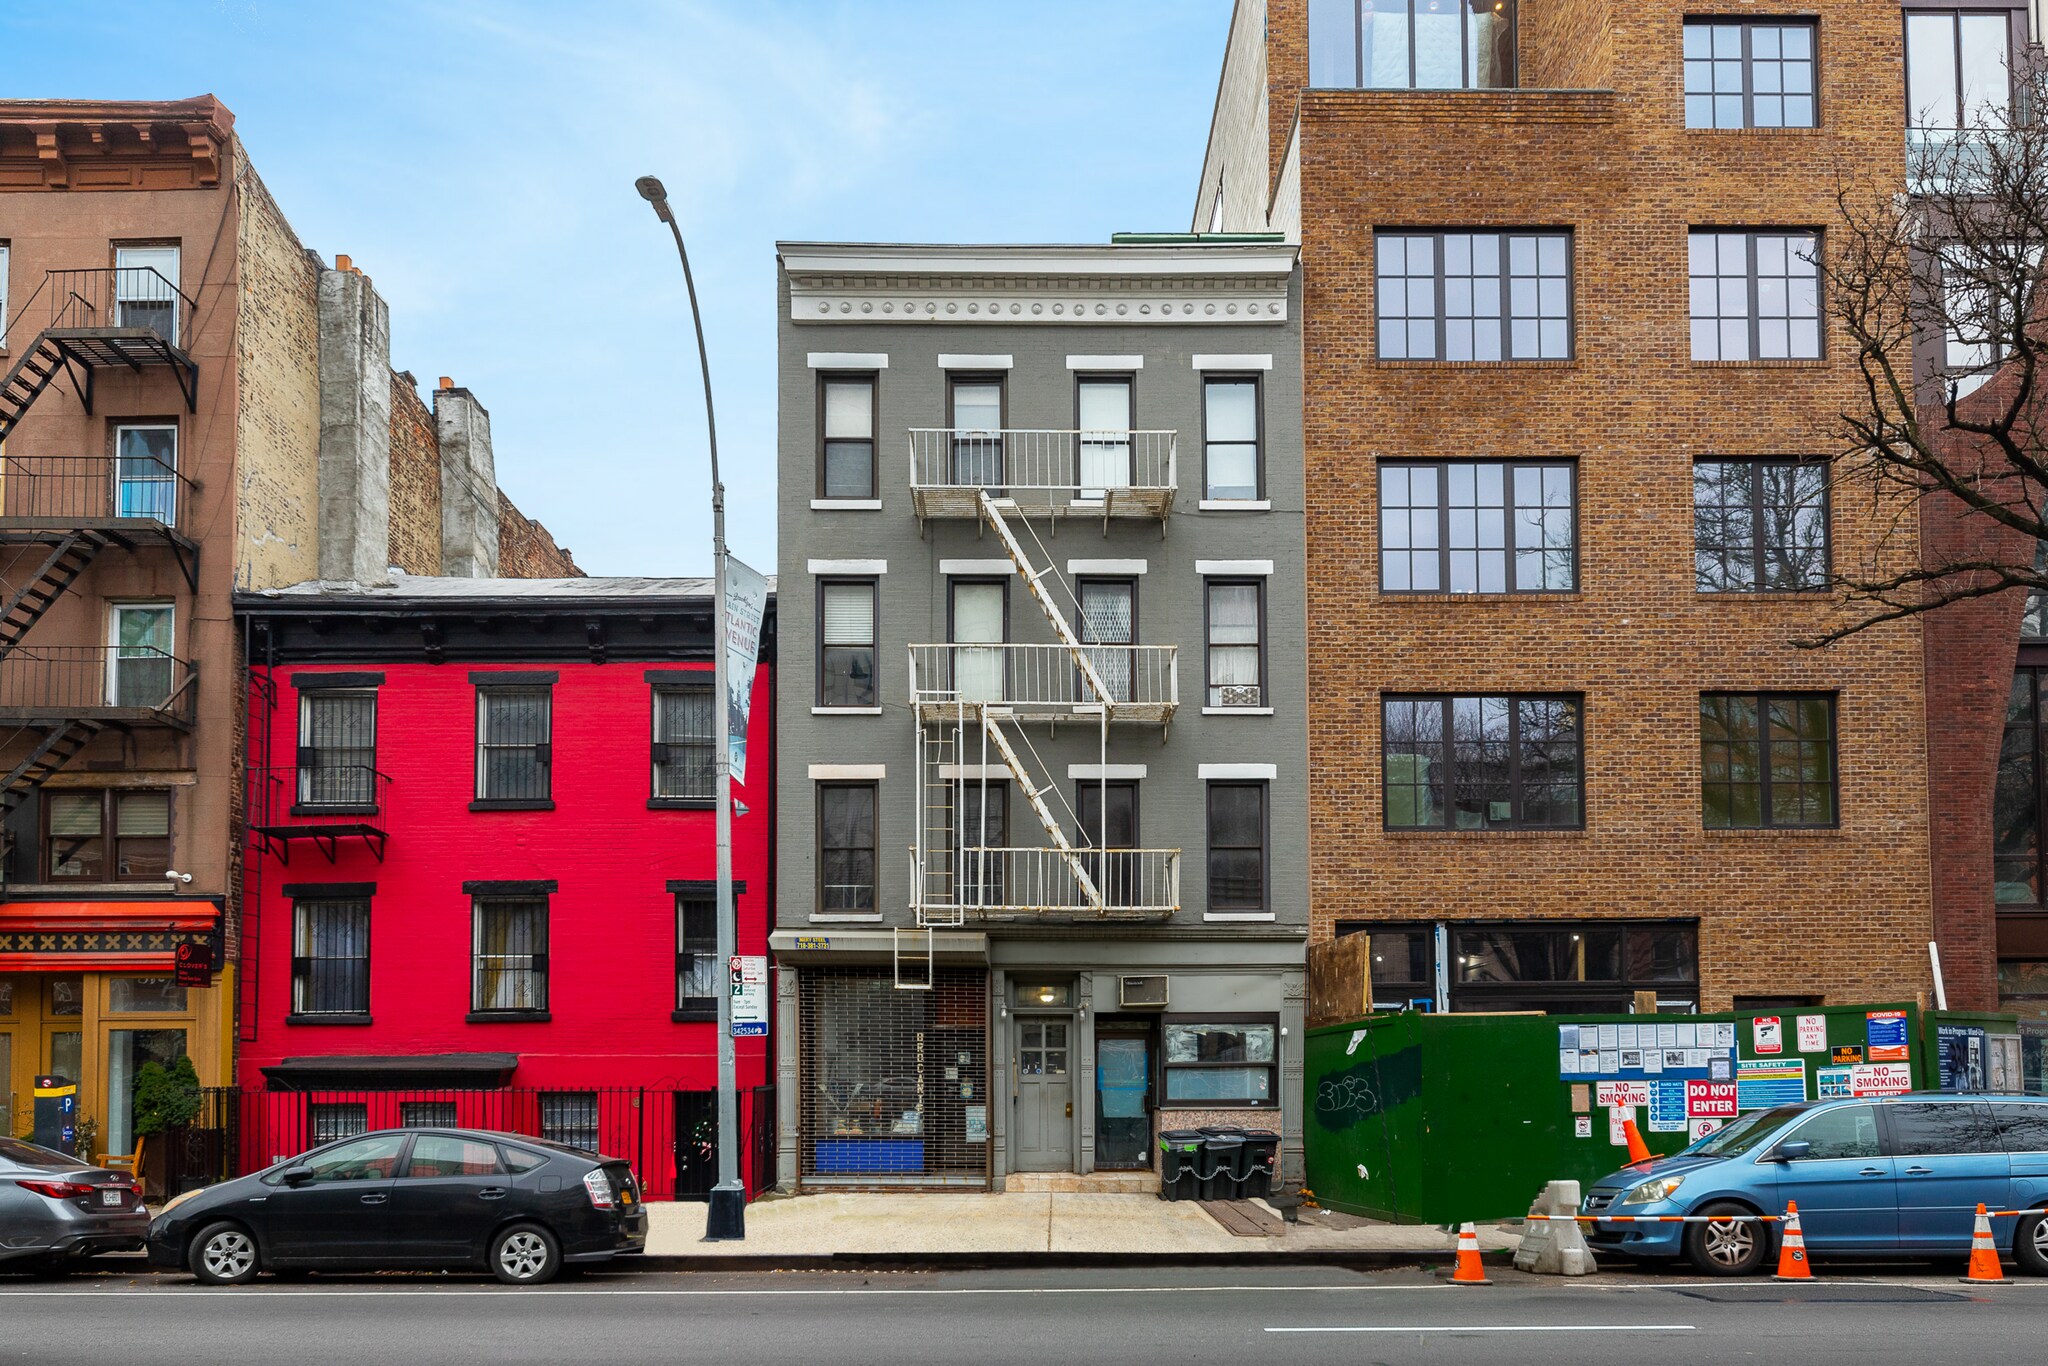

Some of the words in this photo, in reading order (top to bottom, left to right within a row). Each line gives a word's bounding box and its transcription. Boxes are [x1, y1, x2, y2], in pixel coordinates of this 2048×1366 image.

[740, 608, 760, 624] STREET
[726, 611, 757, 638] TLANTIC
[726, 629, 755, 655] VENUE
[734, 984, 741, 995] 2
[1805, 1017, 1817, 1025] NO
[1841, 1047, 1853, 1055] NO
[1833, 1055, 1862, 1063] PARKING
[1873, 1067, 1889, 1076] NO
[1615, 1083, 1630, 1092] NO
[1856, 1077, 1908, 1088] SMOKING
[1690, 1085, 1707, 1096] DO
[1710, 1084, 1735, 1096] NOT
[1600, 1093, 1646, 1104] SMOKING
[1693, 1100, 1734, 1112] ENTER
